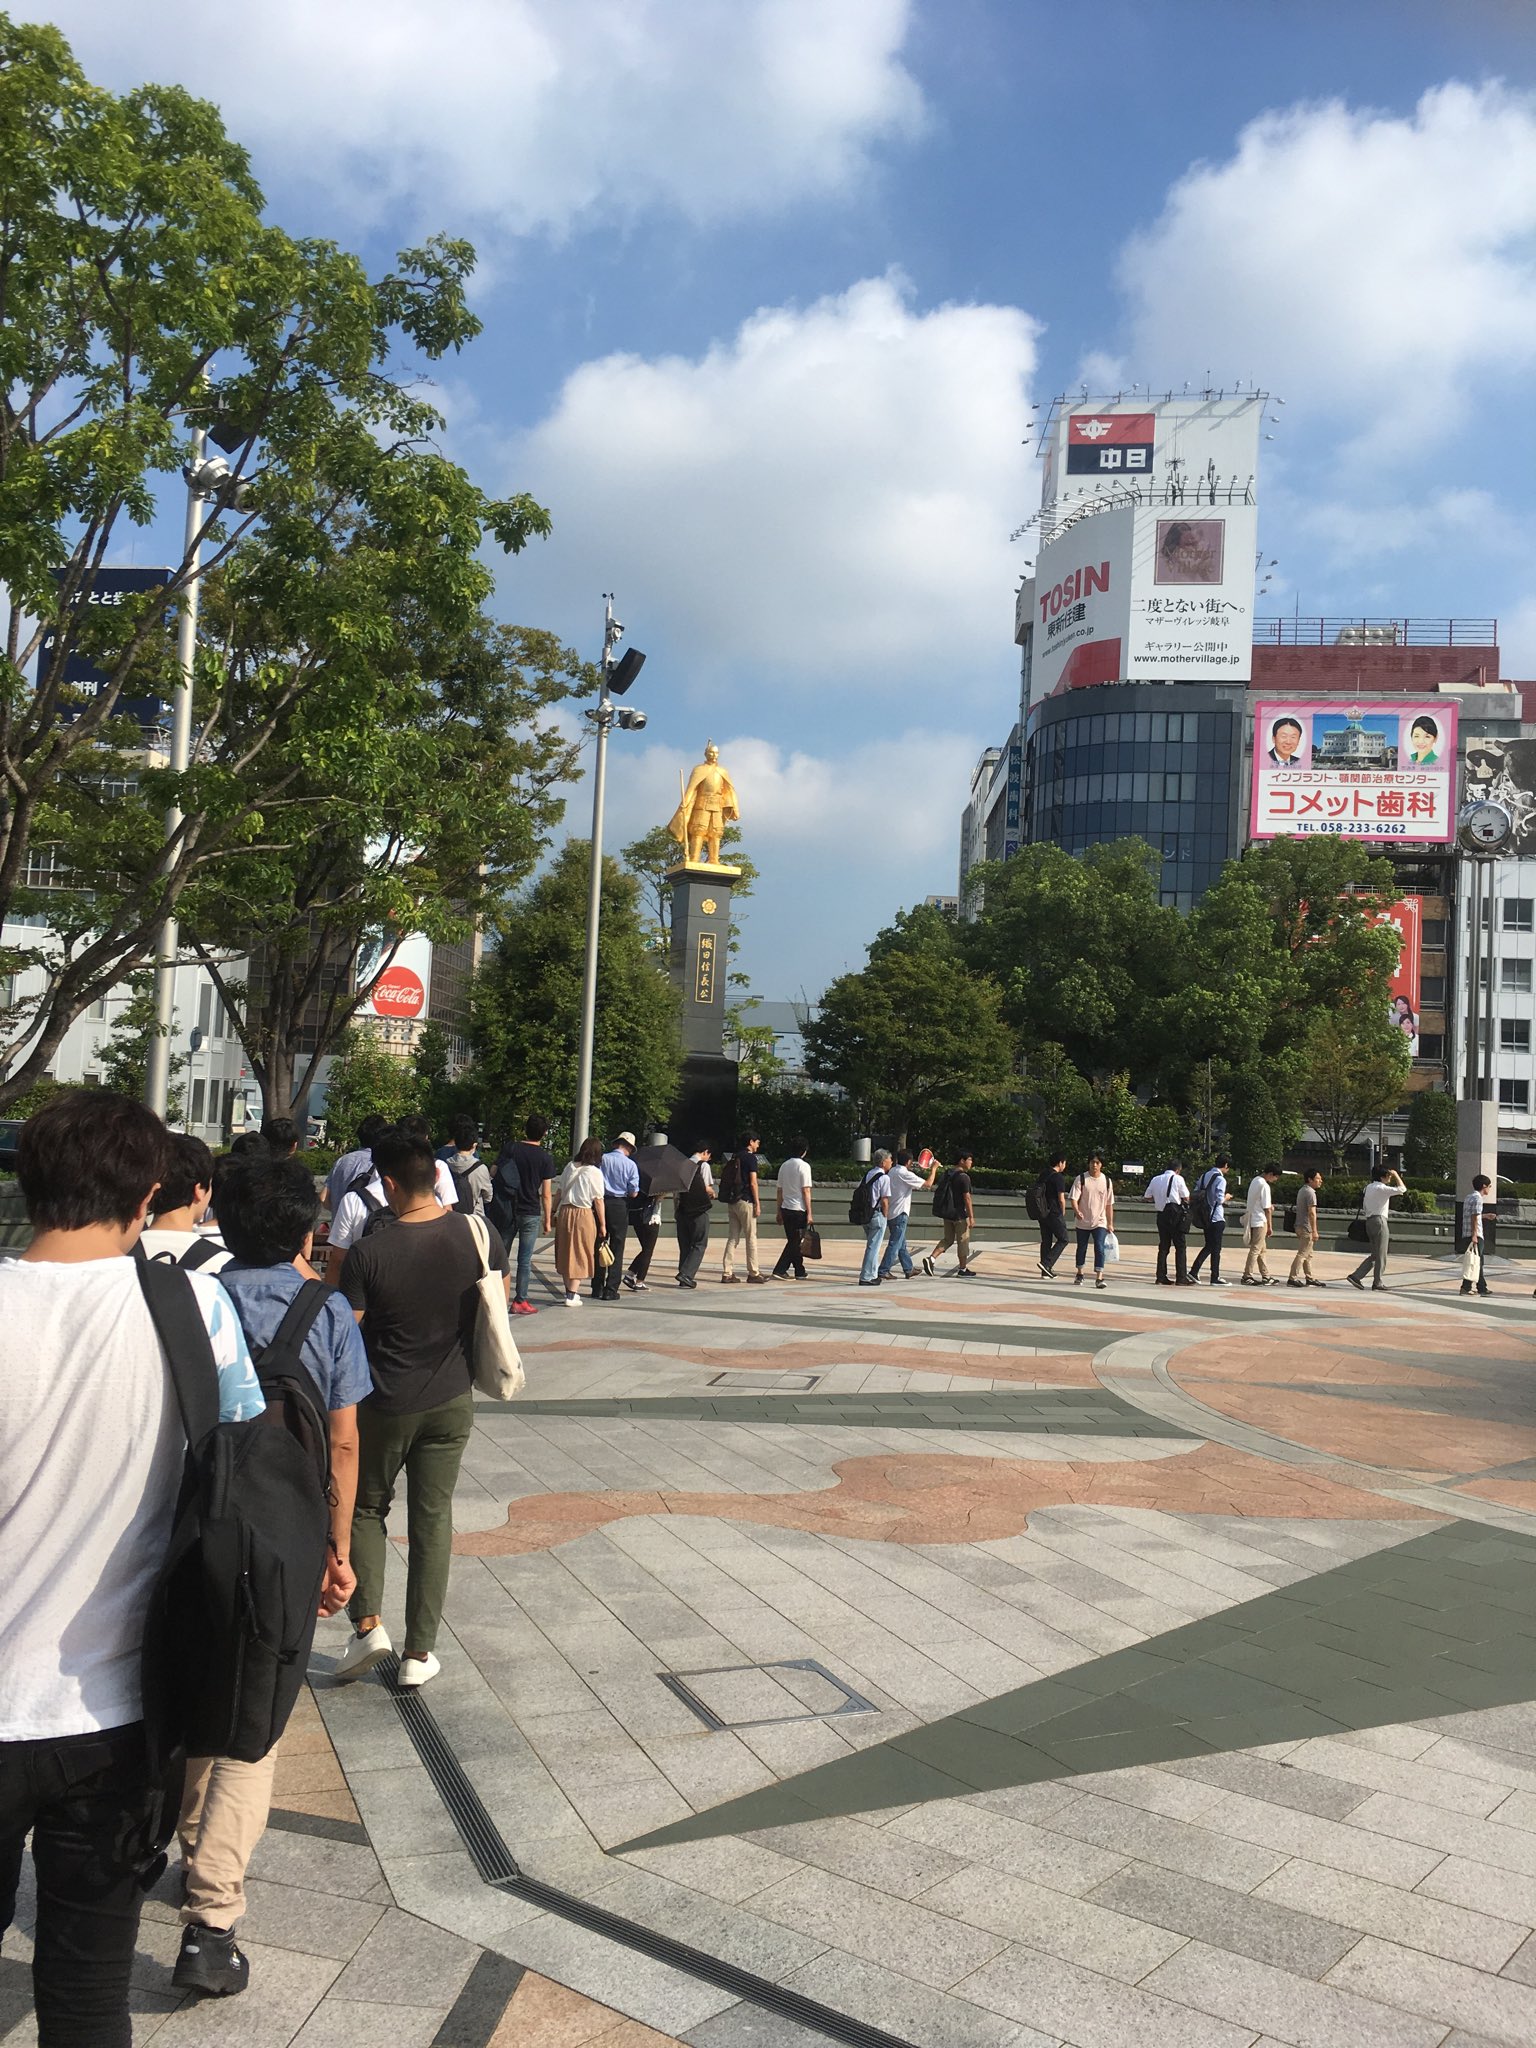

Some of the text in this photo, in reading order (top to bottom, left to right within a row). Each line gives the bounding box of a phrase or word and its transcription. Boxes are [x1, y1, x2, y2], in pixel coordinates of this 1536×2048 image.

[1100, 448, 1147, 469] 中日
[1040, 561, 1111, 623] TOSIN
[1131, 598, 1246, 614] 二度とない街へ。
[1047, 602, 1086, 640] 東新住建
[1145, 616, 1231, 627] マザーヴィレッジ岐阜
[1144, 641, 1229, 653] ギャラリー公開中
[1133, 654, 1241, 665] www.mothervillage.jp
[1271, 772, 1438, 785] インプラント・顎関節治療センター
[1269, 789, 1437, 818] コメット歯科
[1296, 822, 1406, 834] TEL.058-233-6262
[700, 937, 713, 999] 織田信長公
[374, 984, 423, 1005] Coca-Cola
